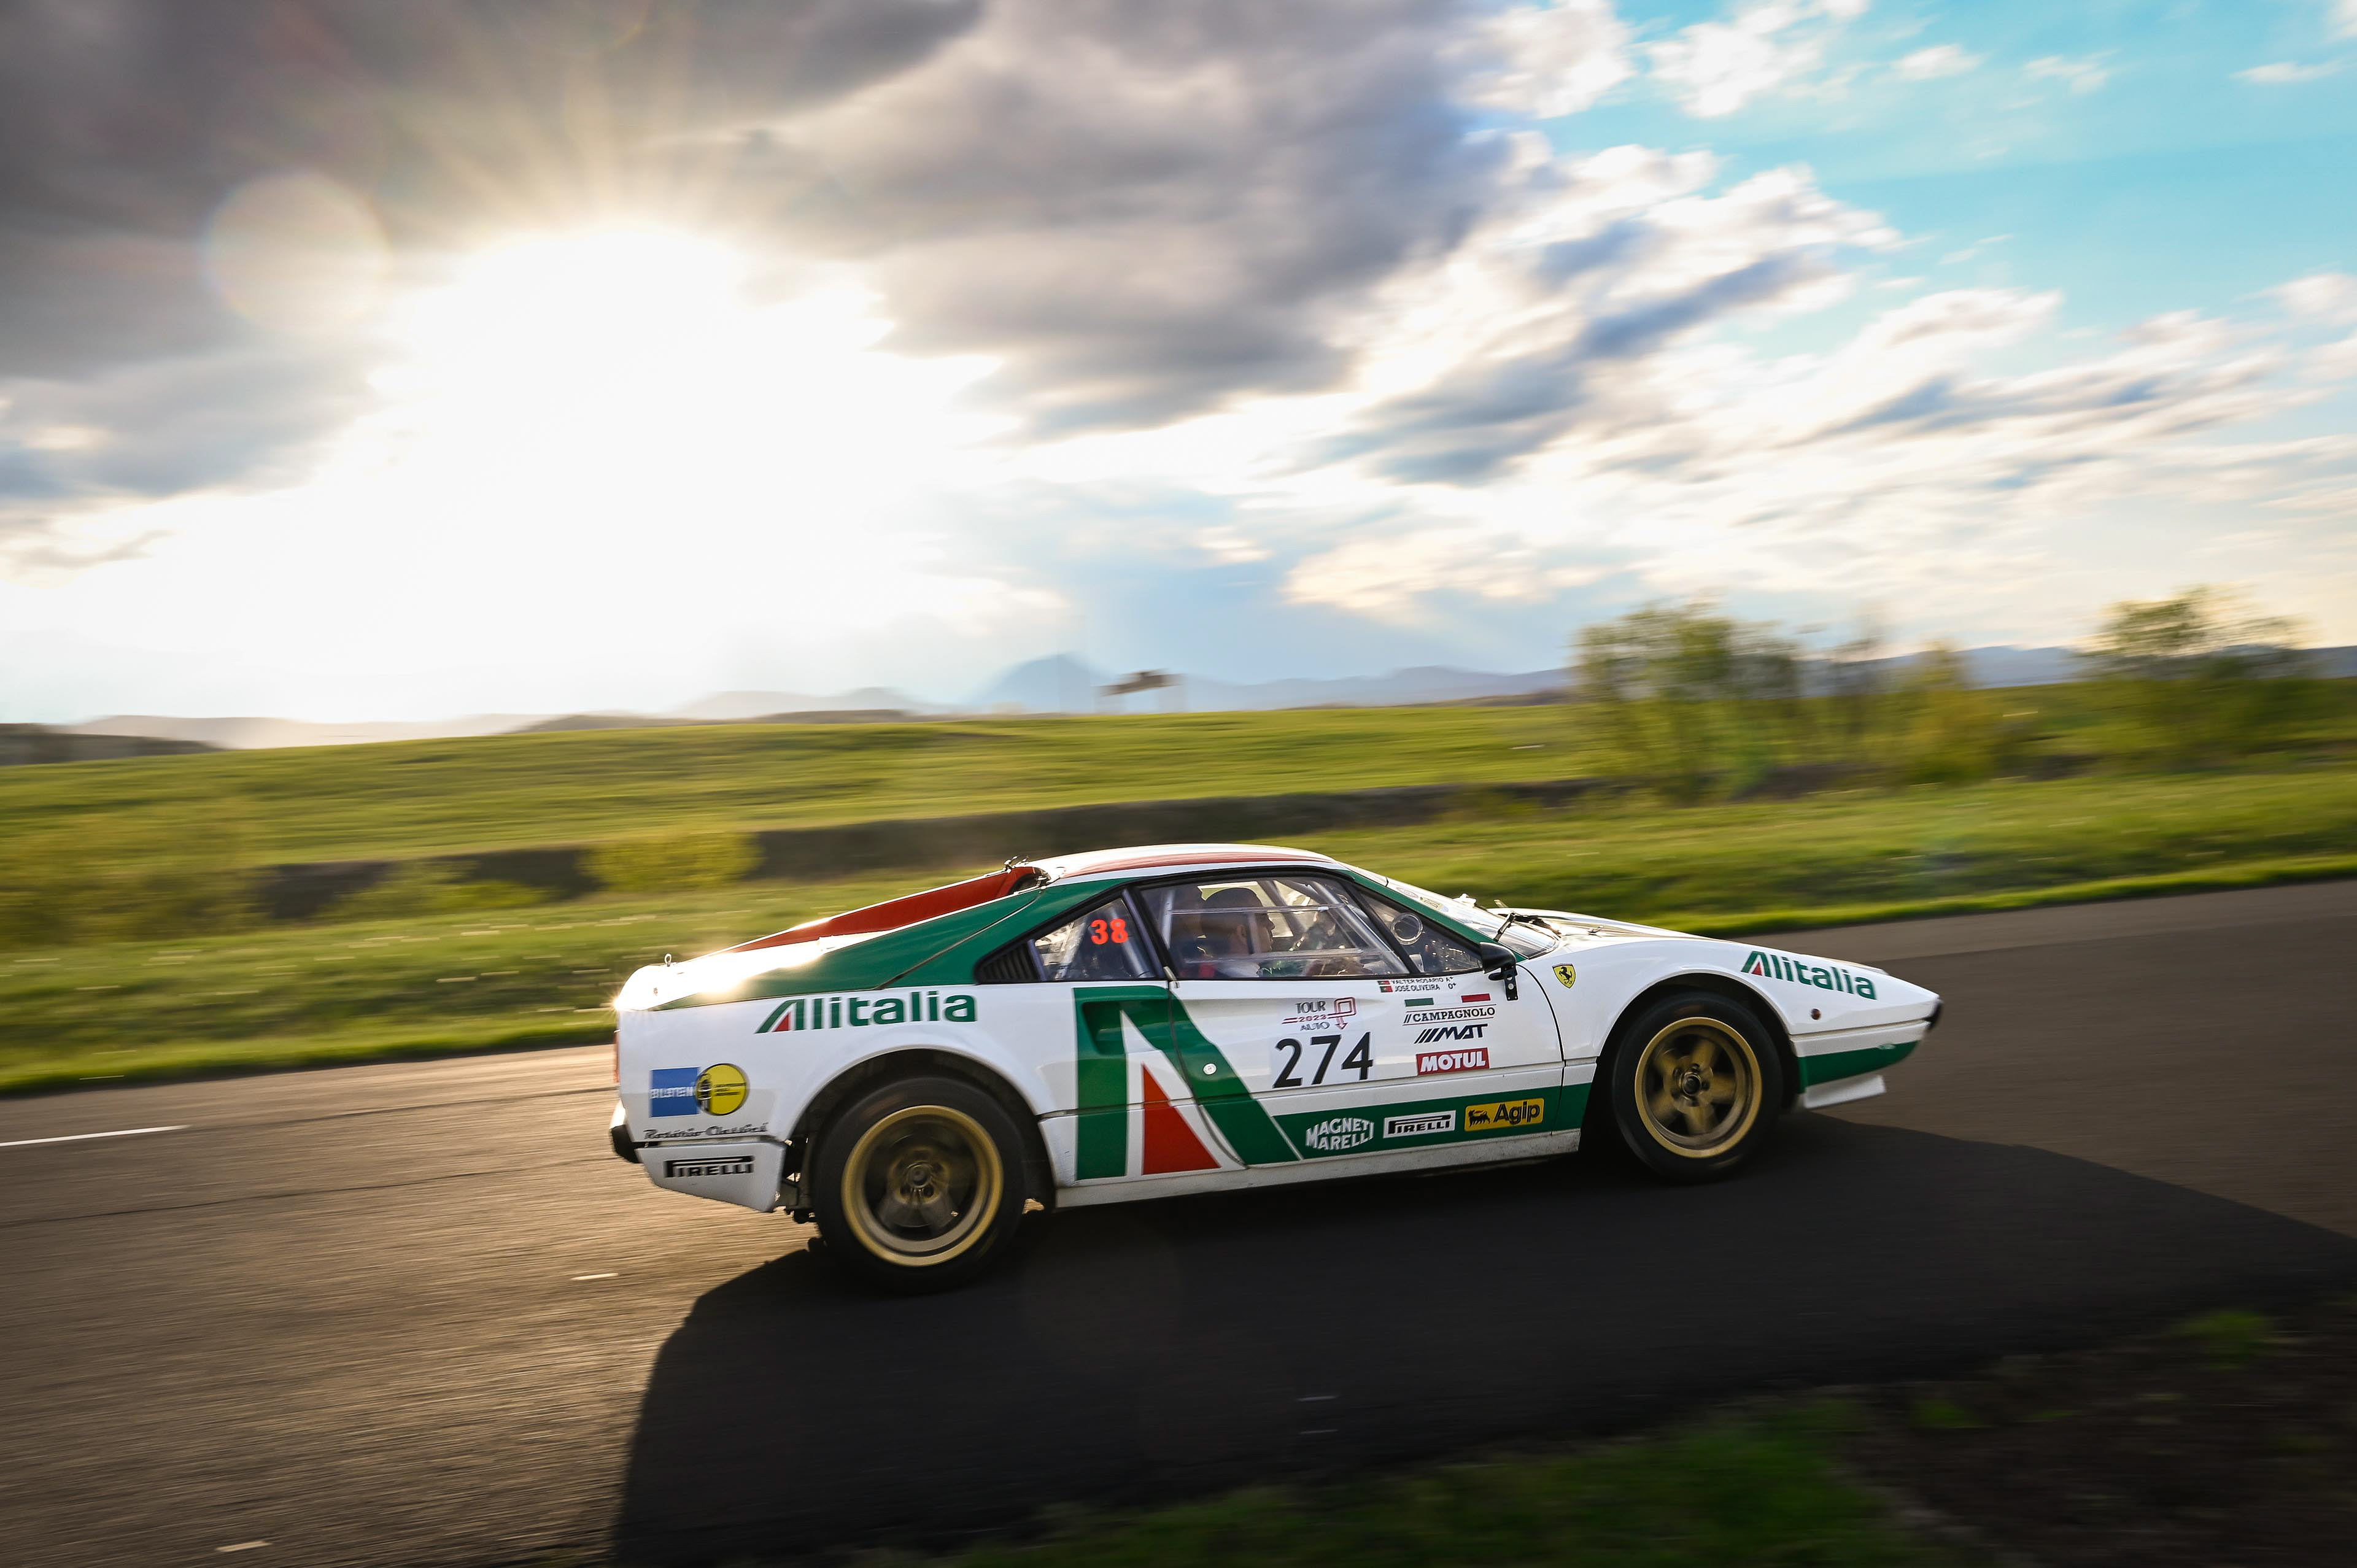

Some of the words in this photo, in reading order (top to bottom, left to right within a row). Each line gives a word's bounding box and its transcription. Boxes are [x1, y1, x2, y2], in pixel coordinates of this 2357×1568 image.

[1091, 918, 1129, 944] 38
[1741, 951, 1878, 1000] Alitalia
[754, 991, 977, 1033] Alitalia
[1295, 1000, 1326, 1014] TOUR
[1300, 1021, 1330, 1031] AUTO
[1272, 1032, 1374, 1089] 274
[1420, 1051, 1486, 1073] MOTUL
[1388, 1114, 1452, 1135] PIRELLI
[1493, 1101, 1541, 1125] Agip
[1306, 1128, 1374, 1151] MARELLI
[664, 1155, 756, 1178] PIRELLI
